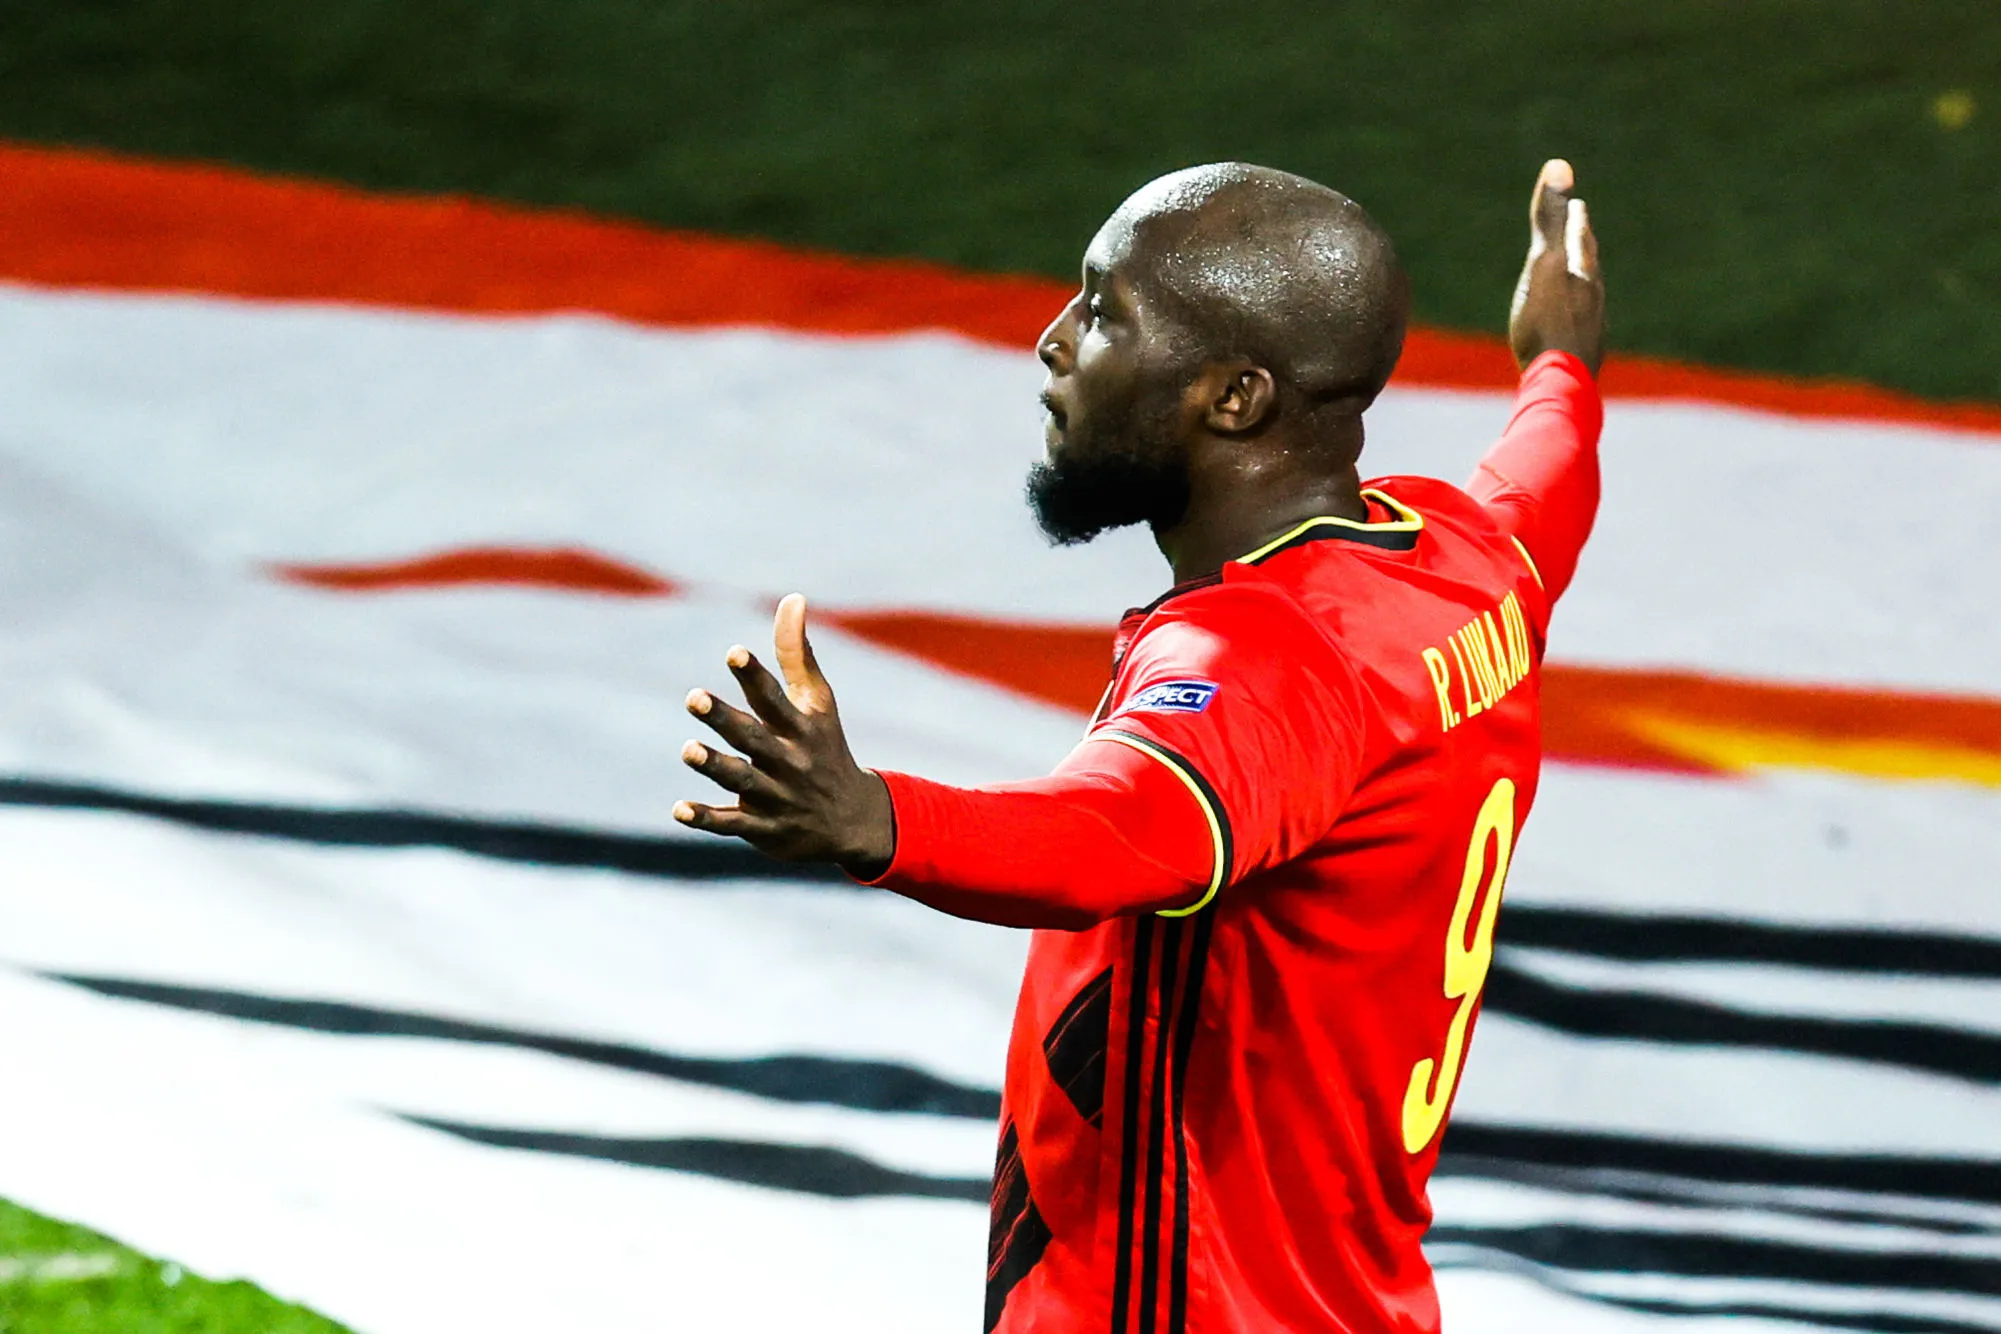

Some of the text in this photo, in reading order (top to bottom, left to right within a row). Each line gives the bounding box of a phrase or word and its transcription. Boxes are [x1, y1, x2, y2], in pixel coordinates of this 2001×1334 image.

[1421, 590, 1529, 732] R. LUKAKU
[1402, 778, 1515, 1154] 9
